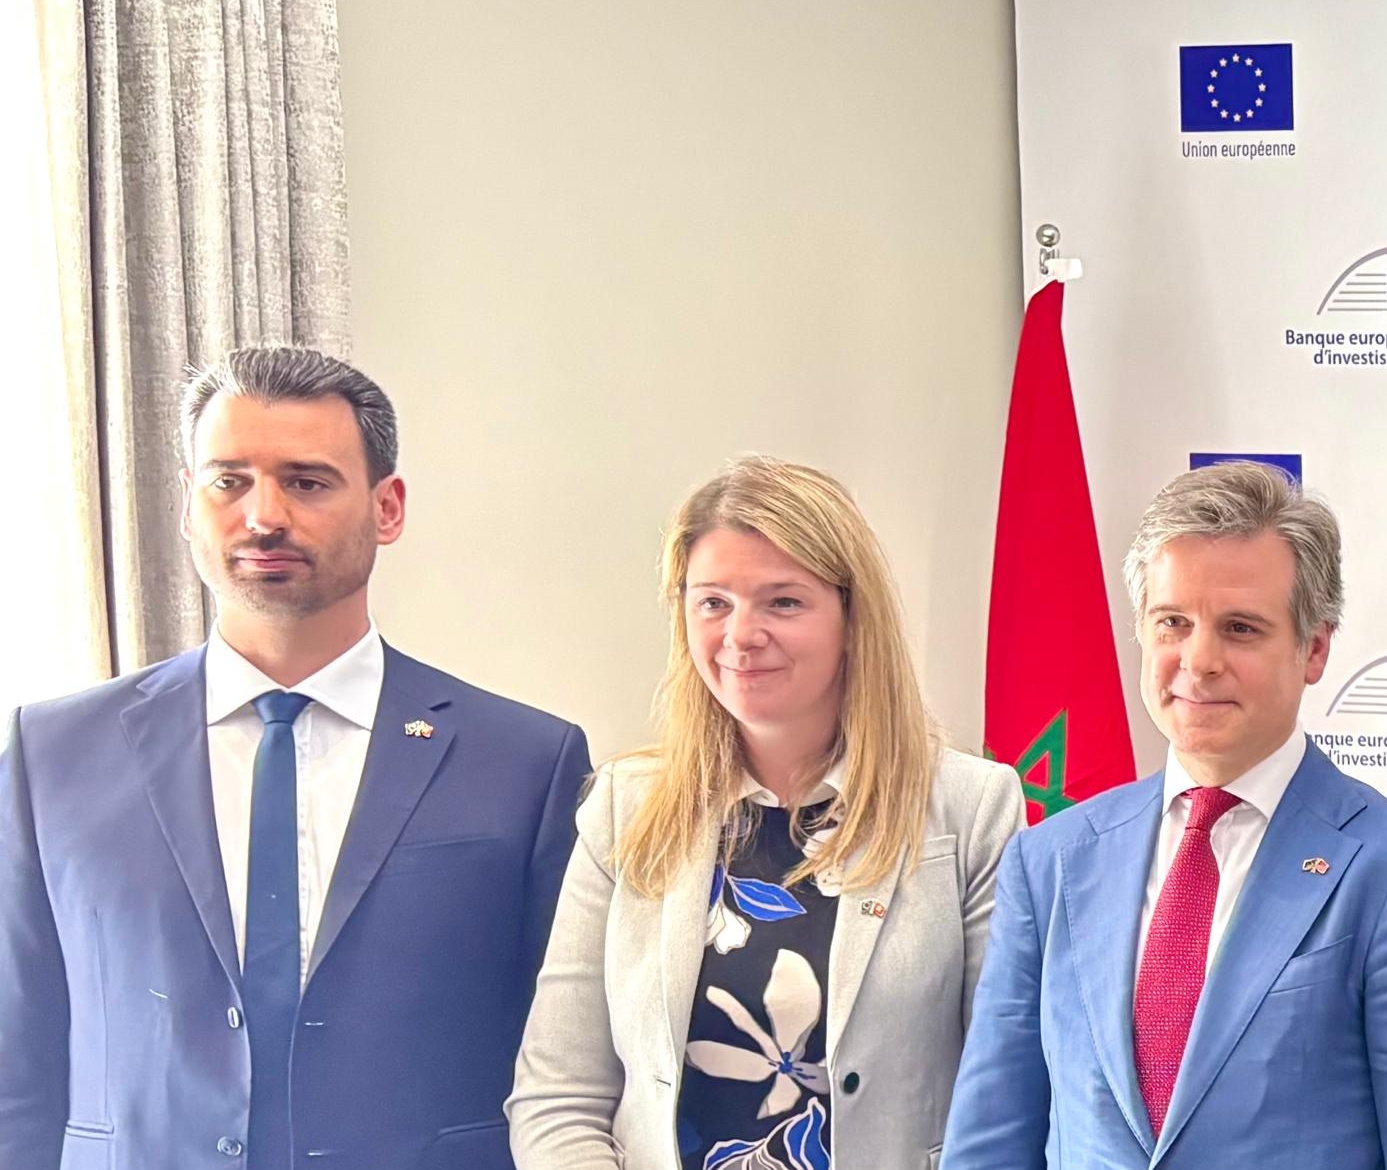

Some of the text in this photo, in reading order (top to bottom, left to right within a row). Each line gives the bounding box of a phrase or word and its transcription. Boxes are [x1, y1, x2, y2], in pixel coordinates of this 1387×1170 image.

[1181, 140, 1296, 160] Union européenne
[1285, 330, 1345, 352] Banque
[1309, 733, 1354, 749] nque
